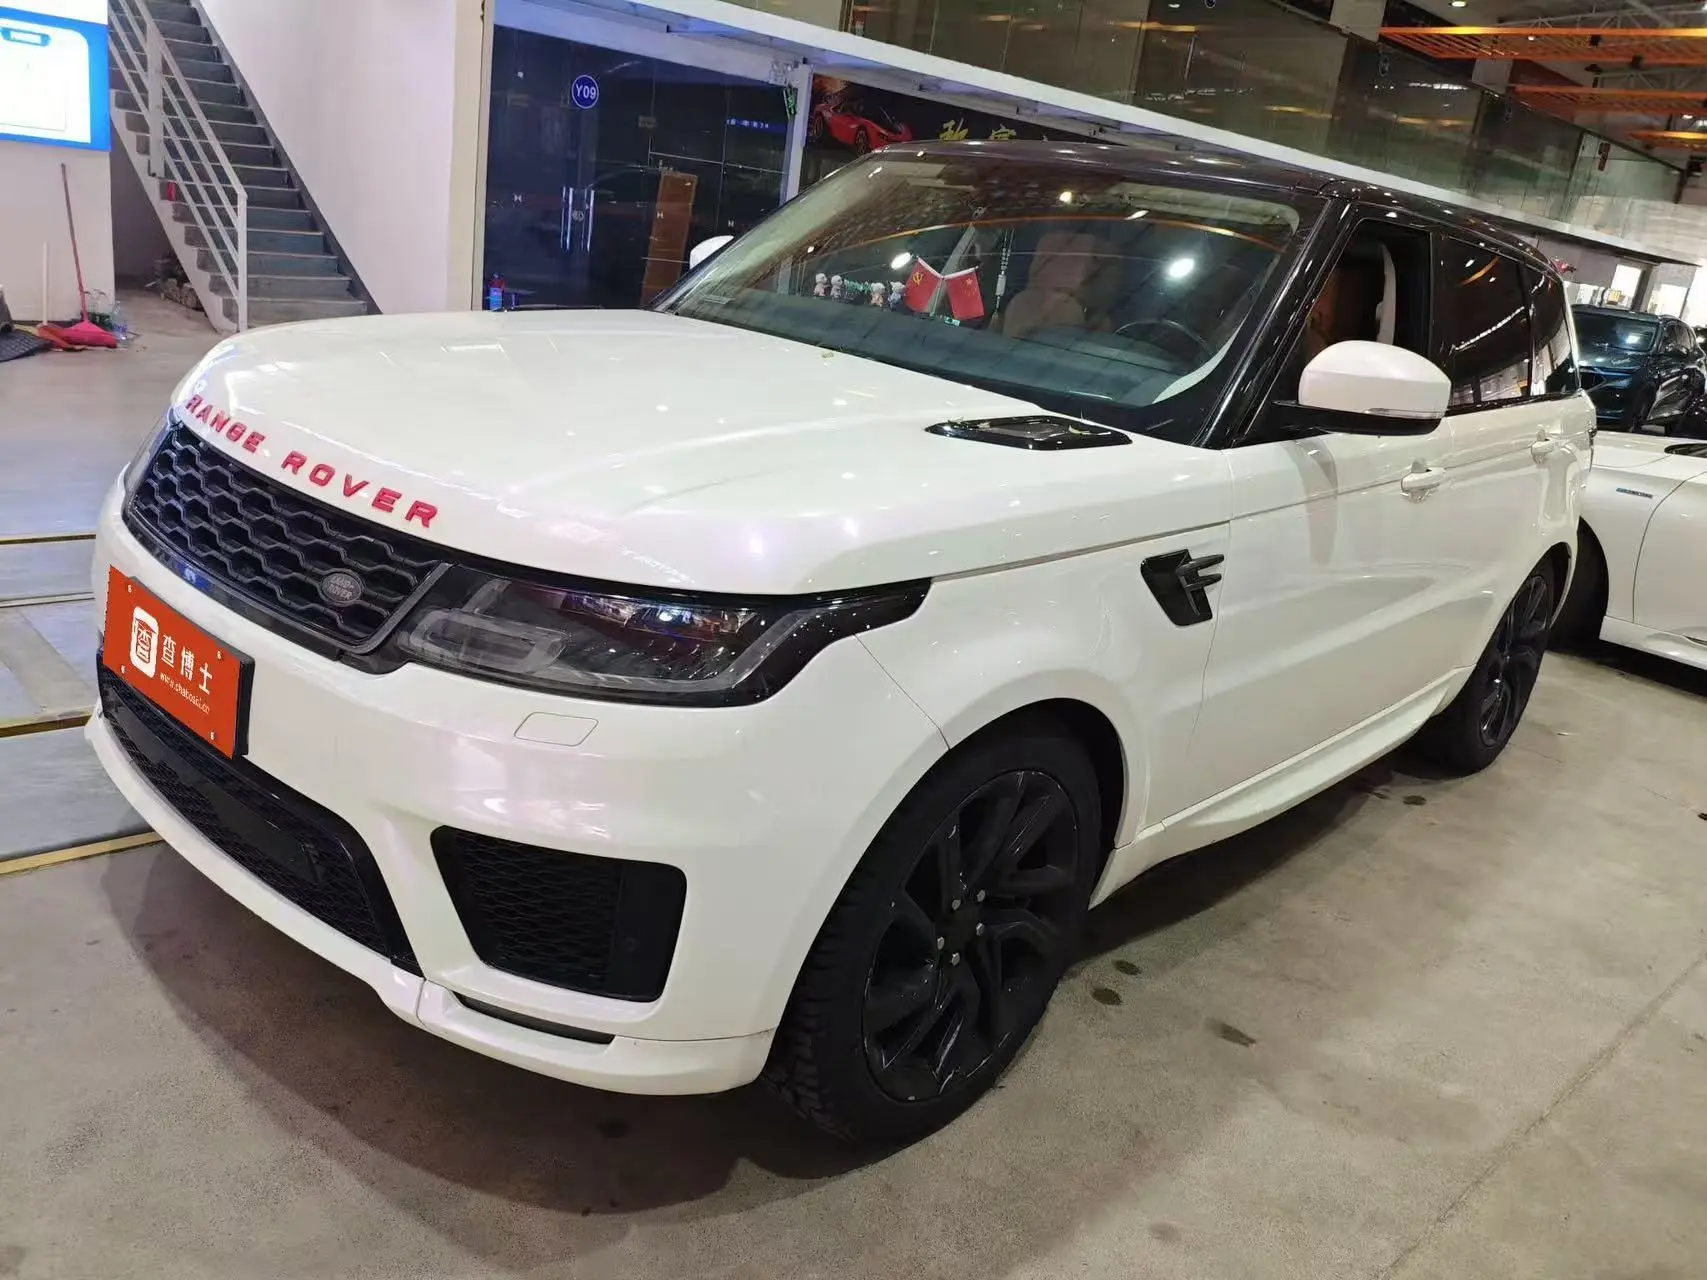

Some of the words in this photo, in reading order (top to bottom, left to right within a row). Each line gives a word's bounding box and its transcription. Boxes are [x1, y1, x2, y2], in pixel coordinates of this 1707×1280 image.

[575, 83, 597, 100] Y09
[184, 393, 266, 454] RANGE
[281, 450, 439, 529] ROVER
[161, 634, 213, 695] 查博士
